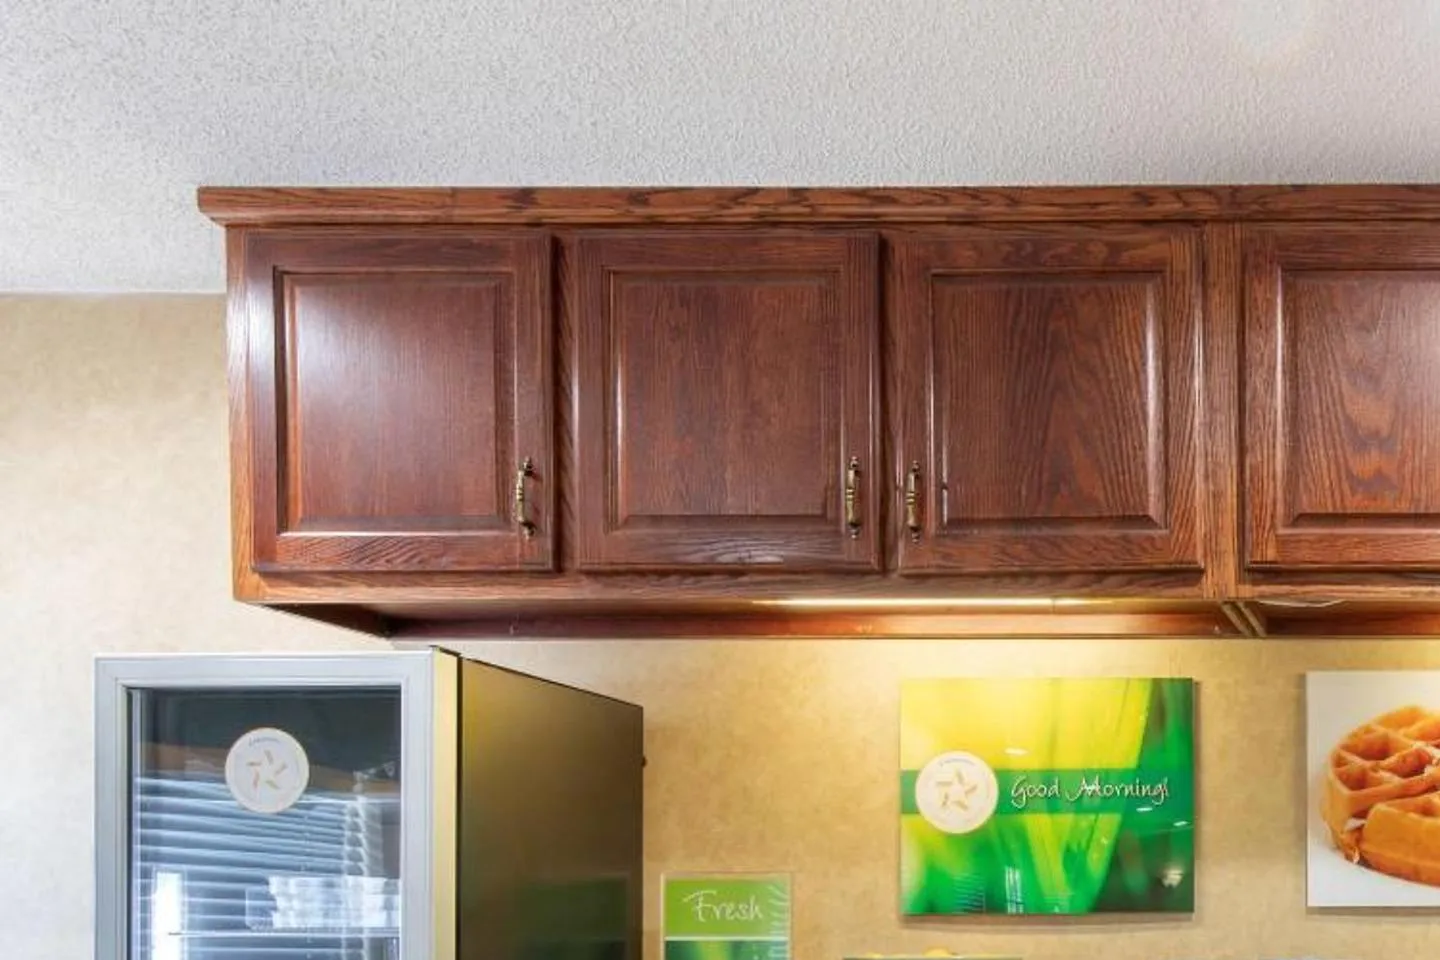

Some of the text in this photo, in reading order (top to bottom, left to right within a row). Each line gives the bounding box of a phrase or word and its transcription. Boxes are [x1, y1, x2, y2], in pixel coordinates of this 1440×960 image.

[1011, 774, 1169, 808] Good Morning!
[682, 889, 764, 922] Fresh
